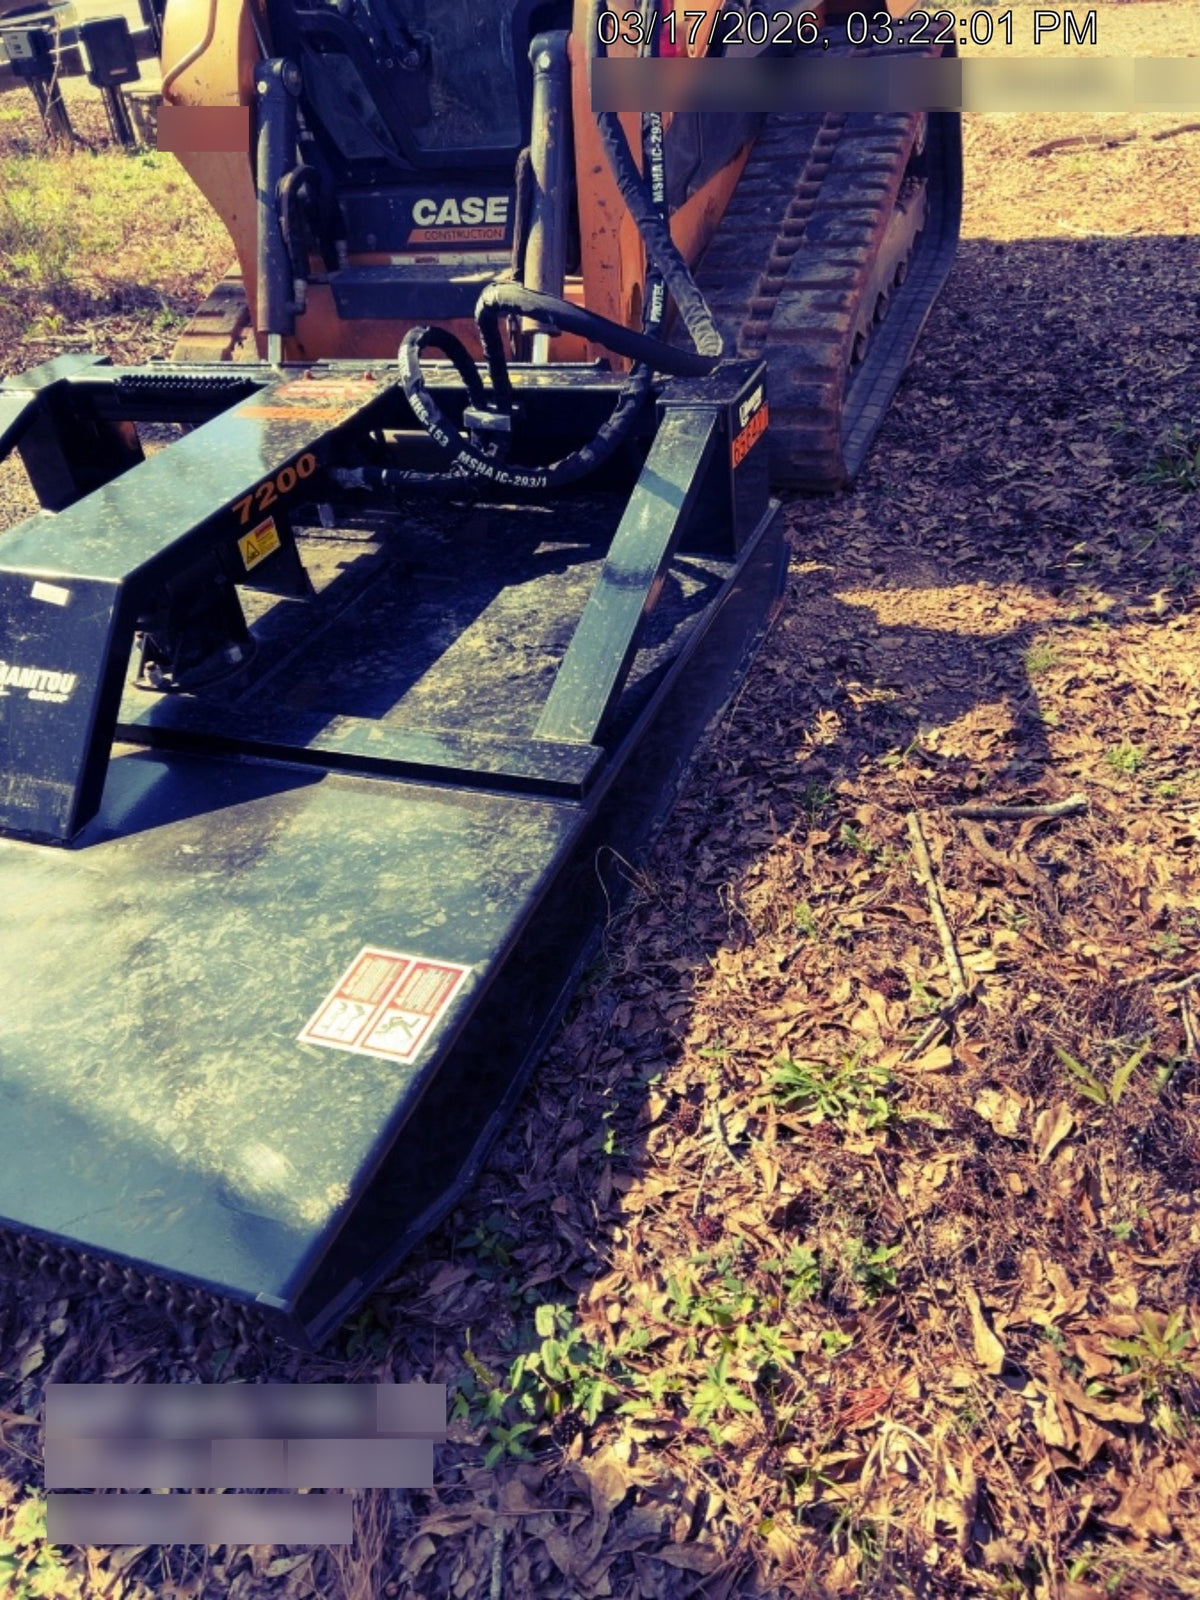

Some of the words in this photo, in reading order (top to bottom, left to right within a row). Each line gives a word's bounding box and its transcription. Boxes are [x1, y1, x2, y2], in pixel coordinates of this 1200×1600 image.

[651, 163, 664, 203] MSHA
[412, 196, 509, 226] CASE
[424, 229, 502, 240] CONSTRUCTION
[458, 451, 494, 478] MSHA
[231, 453, 316, 525] 7200
